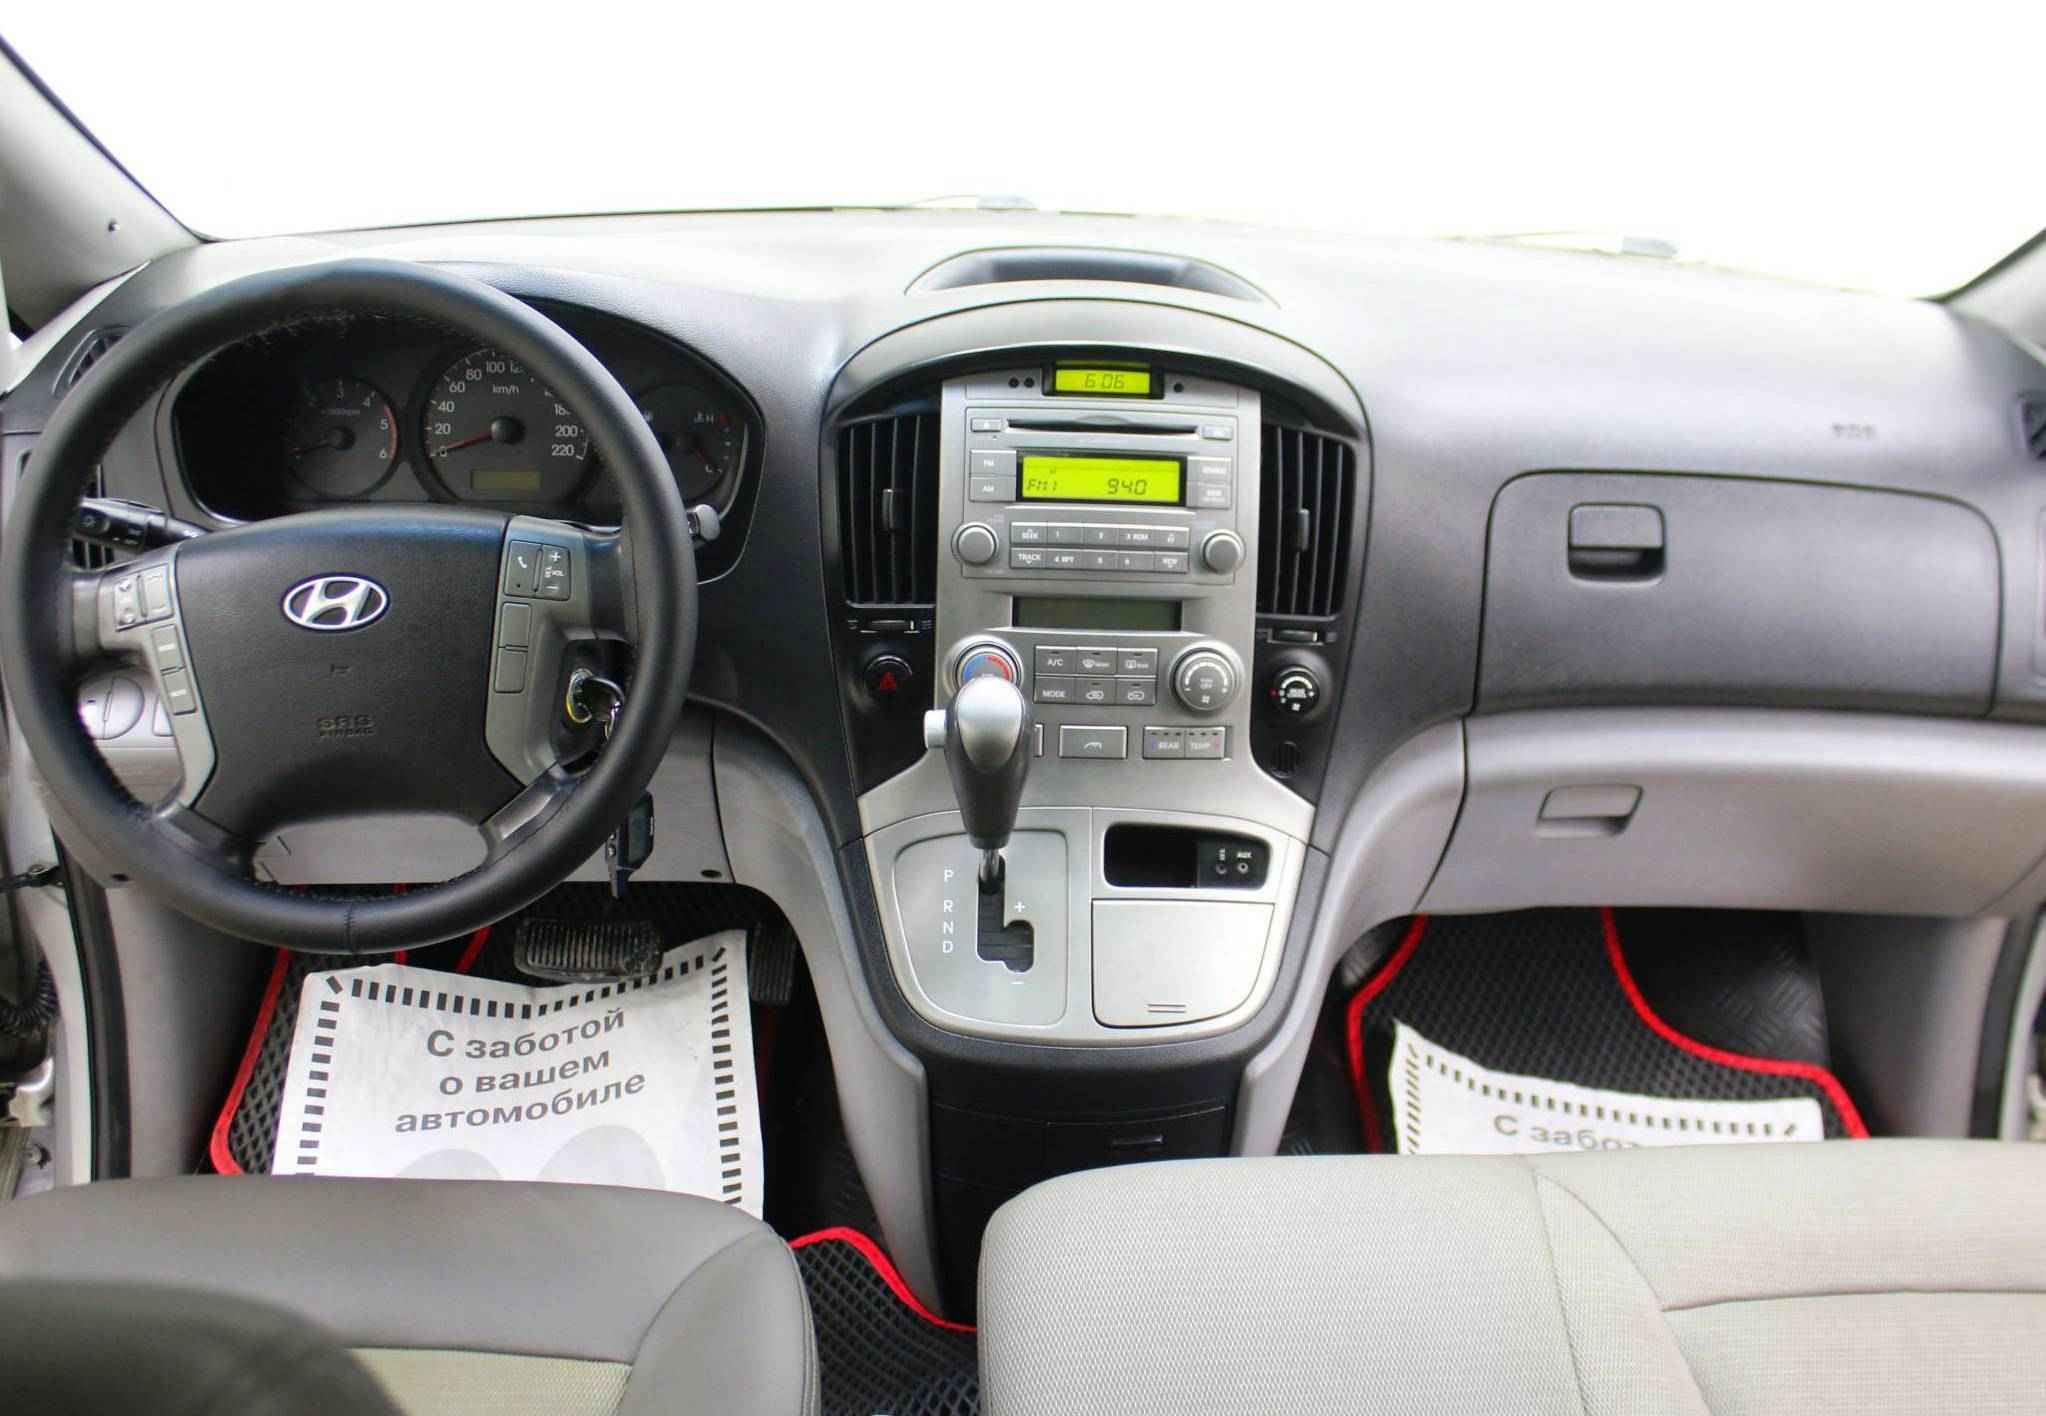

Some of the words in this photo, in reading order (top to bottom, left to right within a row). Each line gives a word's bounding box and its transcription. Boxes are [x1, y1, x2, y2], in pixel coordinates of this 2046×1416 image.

[485, 361, 505, 374] 100
[466, 369, 481, 381] 80
[450, 381, 465, 393] 60
[492, 383, 520, 394] km/h
[438, 401, 455, 413] 40
[379, 418, 388, 431] 5
[434, 422, 451, 435] 20
[555, 425, 578, 437] 200
[552, 444, 575, 457] 220
[1018, 552, 1042, 562] TRACK
[1047, 657, 1064, 668] A/C
[1042, 689, 1066, 699] MODE
[943, 869, 953, 881] P
[943, 899, 953, 912] R
[943, 920, 953, 933] N
[942, 940, 953, 953] D
[427, 1029, 455, 1057] С
[464, 1007, 625, 1060] заботой
[439, 1075, 463, 1096] о
[475, 1049, 611, 1094] вашем
[394, 1072, 646, 1133] автомобиле
[1493, 1115, 1518, 1136] С
